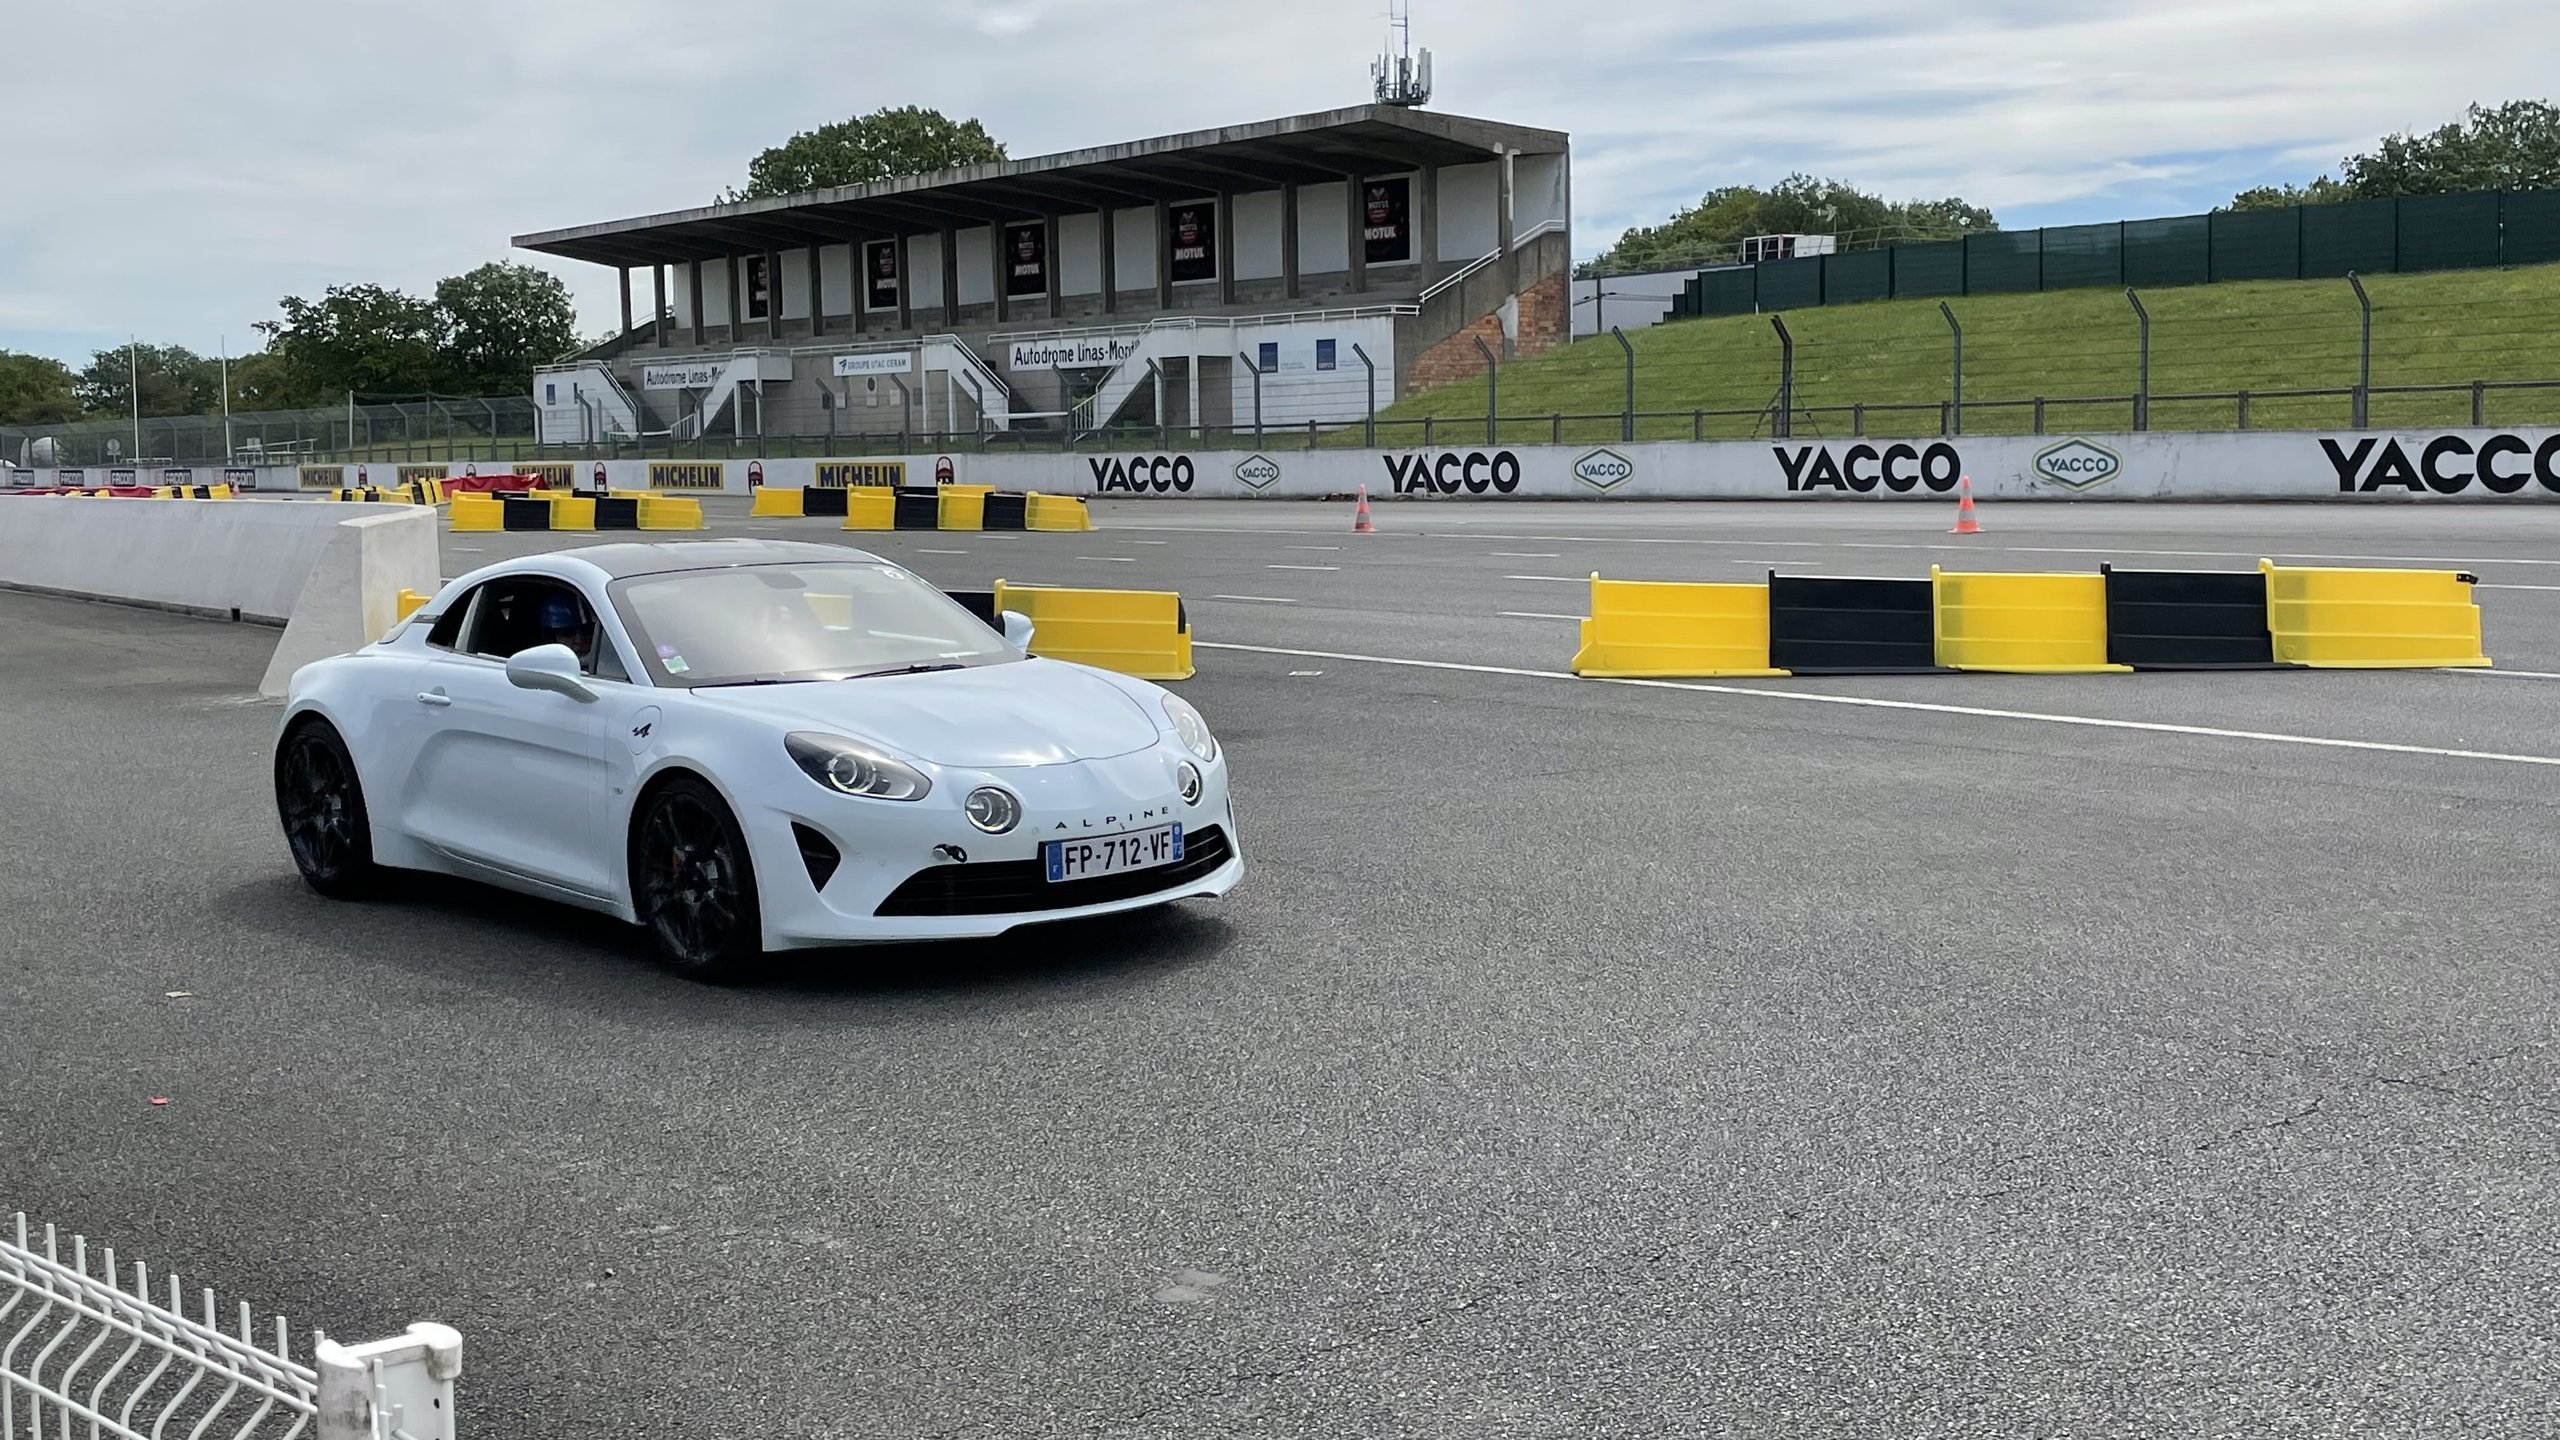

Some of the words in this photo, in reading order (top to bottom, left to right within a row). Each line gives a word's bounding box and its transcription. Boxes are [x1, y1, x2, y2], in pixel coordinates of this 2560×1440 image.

[1365, 226, 1397, 240] MOTUL
[1175, 247, 1205, 261] MOTUL
[876, 278, 897, 290] MOTU
[887, 358, 907, 368] CERAM
[1014, 345, 1074, 366] Autodrome
[646, 369, 687, 385] Autodrome
[1088, 455, 1194, 493] YACCO
[1241, 466, 1275, 478] YACCO
[1382, 450, 1521, 494] YACCO
[1581, 463, 1626, 476] YACCO
[1772, 442, 1961, 492] YACCO
[2046, 457, 2109, 473] YACCO
[302, 468, 343, 487] MICHELIN
[653, 466, 720, 487] MICHELIN
[820, 465, 901, 487] MICHELIN
[1055, 806, 1169, 829] ALPINE
[1065, 831, 1170, 875] FP-712-VF
